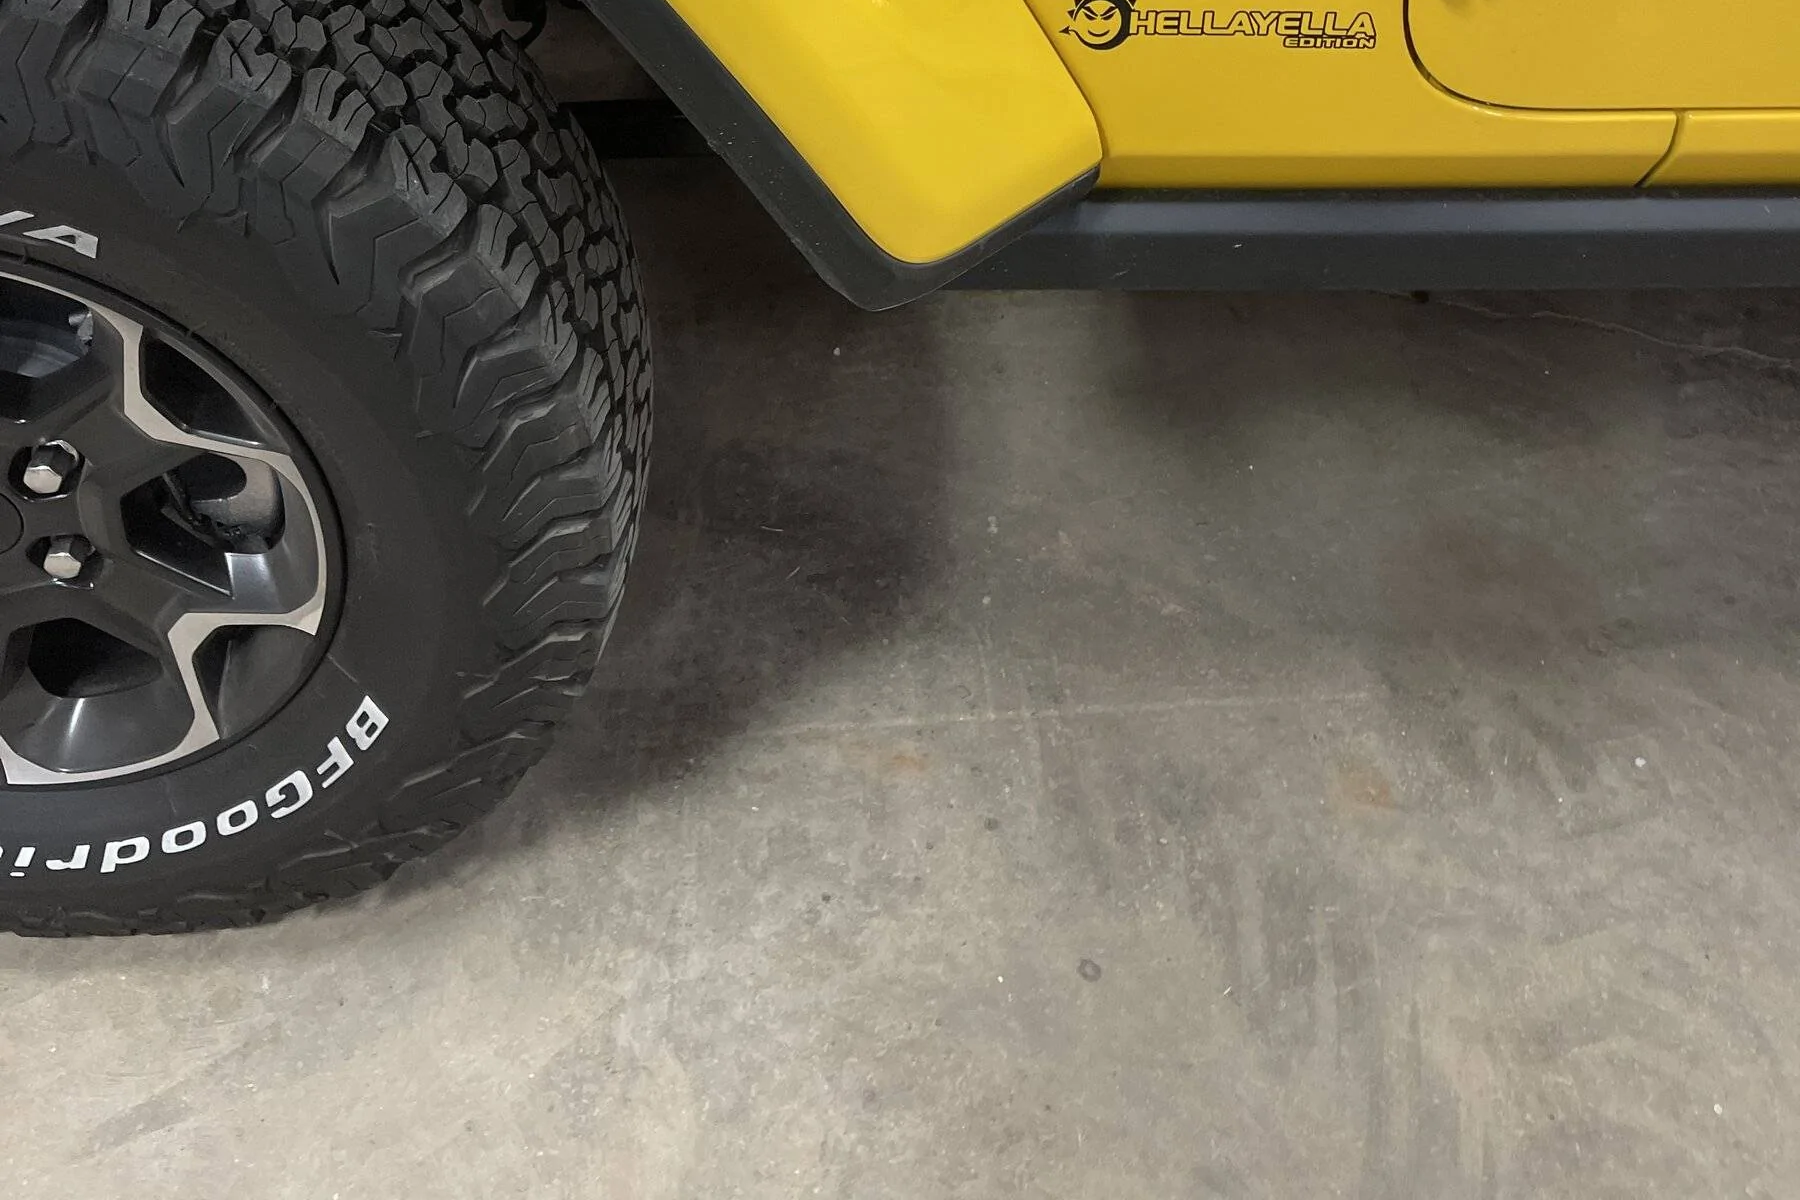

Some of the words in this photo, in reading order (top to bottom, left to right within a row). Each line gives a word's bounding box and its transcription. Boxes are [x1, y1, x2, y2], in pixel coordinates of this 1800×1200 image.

[1128, 10, 1377, 37] HELLAYELLA
[1283, 36, 1376, 49] EDITION
[0, 694, 390, 877] BFGoodri
